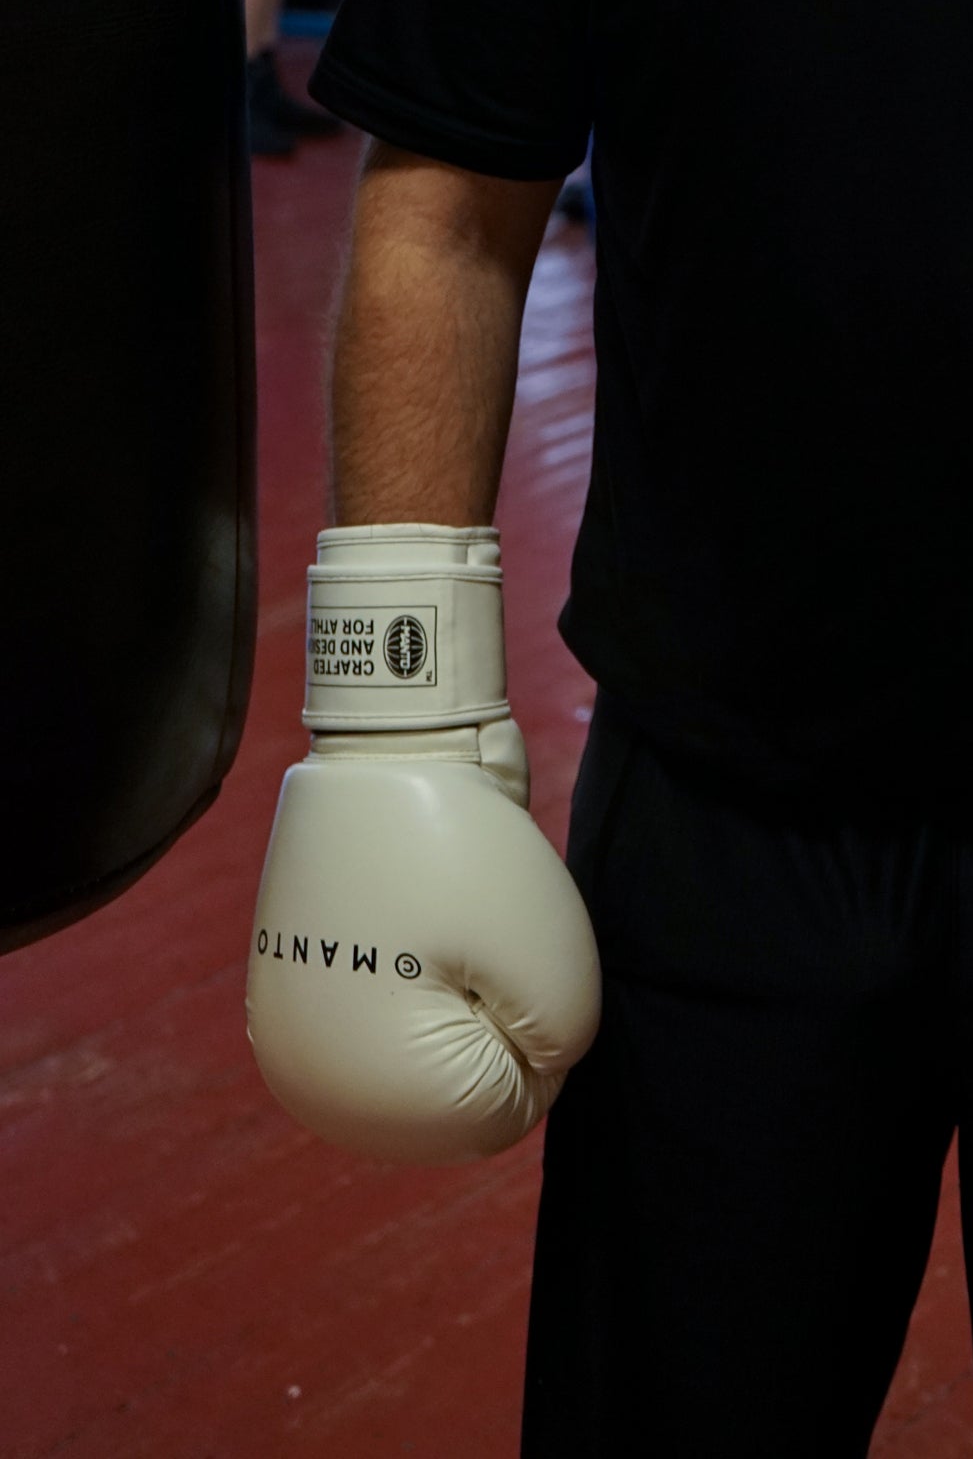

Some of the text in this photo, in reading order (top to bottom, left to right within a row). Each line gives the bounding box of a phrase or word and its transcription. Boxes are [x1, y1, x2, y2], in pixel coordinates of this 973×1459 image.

[342, 619, 374, 635] FOR
[340, 639, 375, 655] AND
[313, 659, 375, 676] CRAFTED
